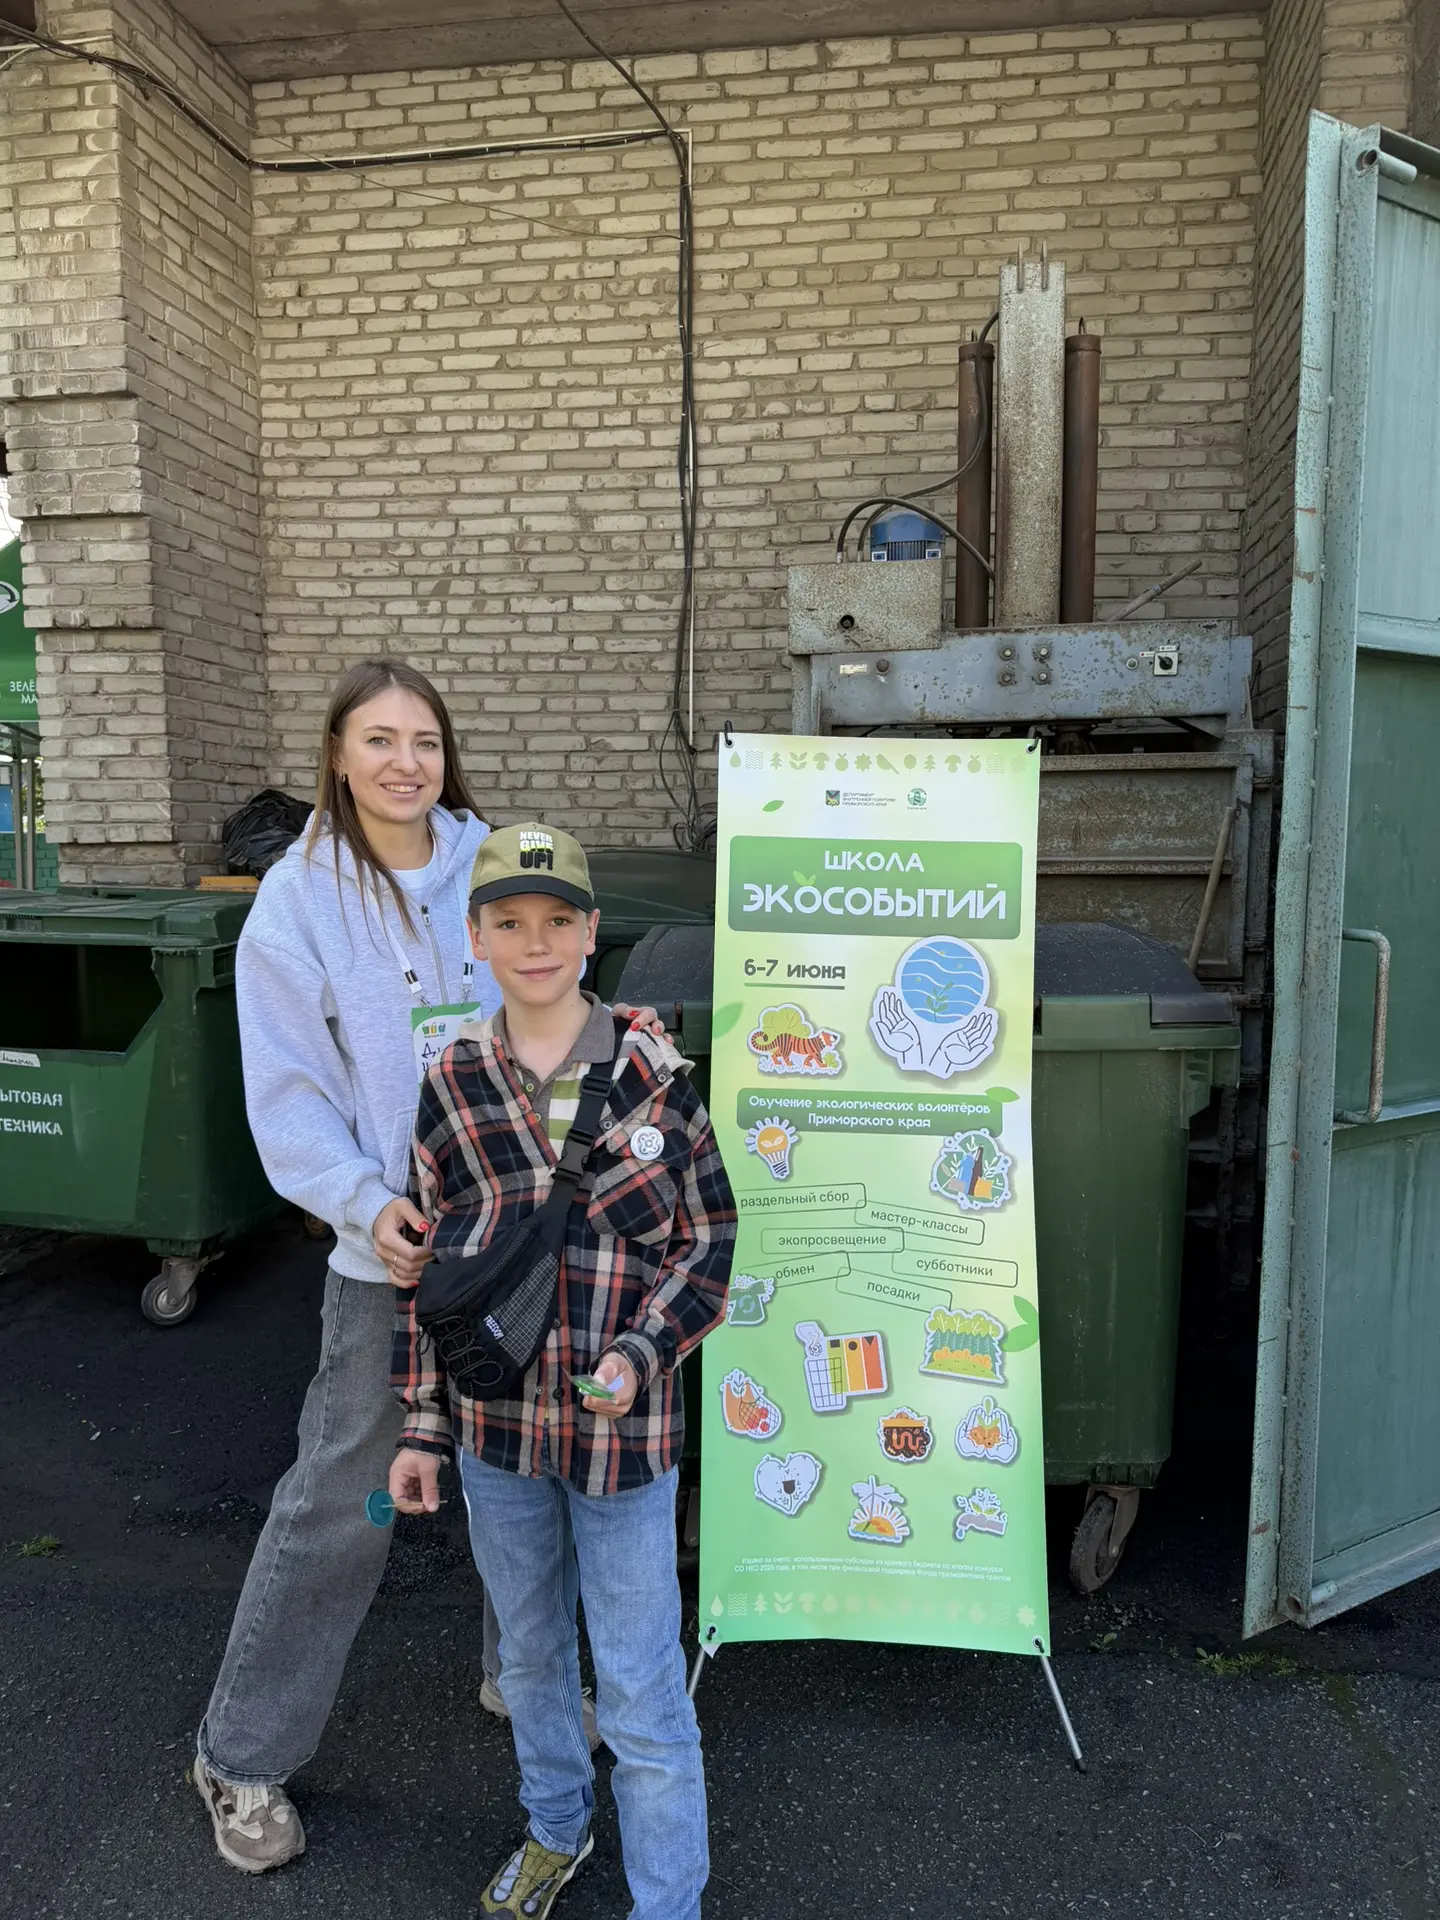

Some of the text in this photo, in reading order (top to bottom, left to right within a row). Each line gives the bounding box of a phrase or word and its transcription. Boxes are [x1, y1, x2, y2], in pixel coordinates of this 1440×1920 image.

[520, 831, 553, 842] NEVER
[520, 851, 554, 871] UP!
[824, 850, 925, 873] ШКОЛА
[742, 883, 1006, 919] ЭКОСОБЫТИЙ
[744, 959, 846, 979] 6-7 июня
[749, 1095, 991, 1116] Обучение экологических волонтёров
[808, 1112, 931, 1128] Приморского края
[741, 1191, 850, 1209] раздельный сбор
[870, 1209, 968, 1235] мастер-классы
[778, 1235, 887, 1248] экопросвещение
[775, 1264, 815, 1279] обмен
[916, 1258, 993, 1277] субботники
[866, 1280, 921, 1302] посадки
